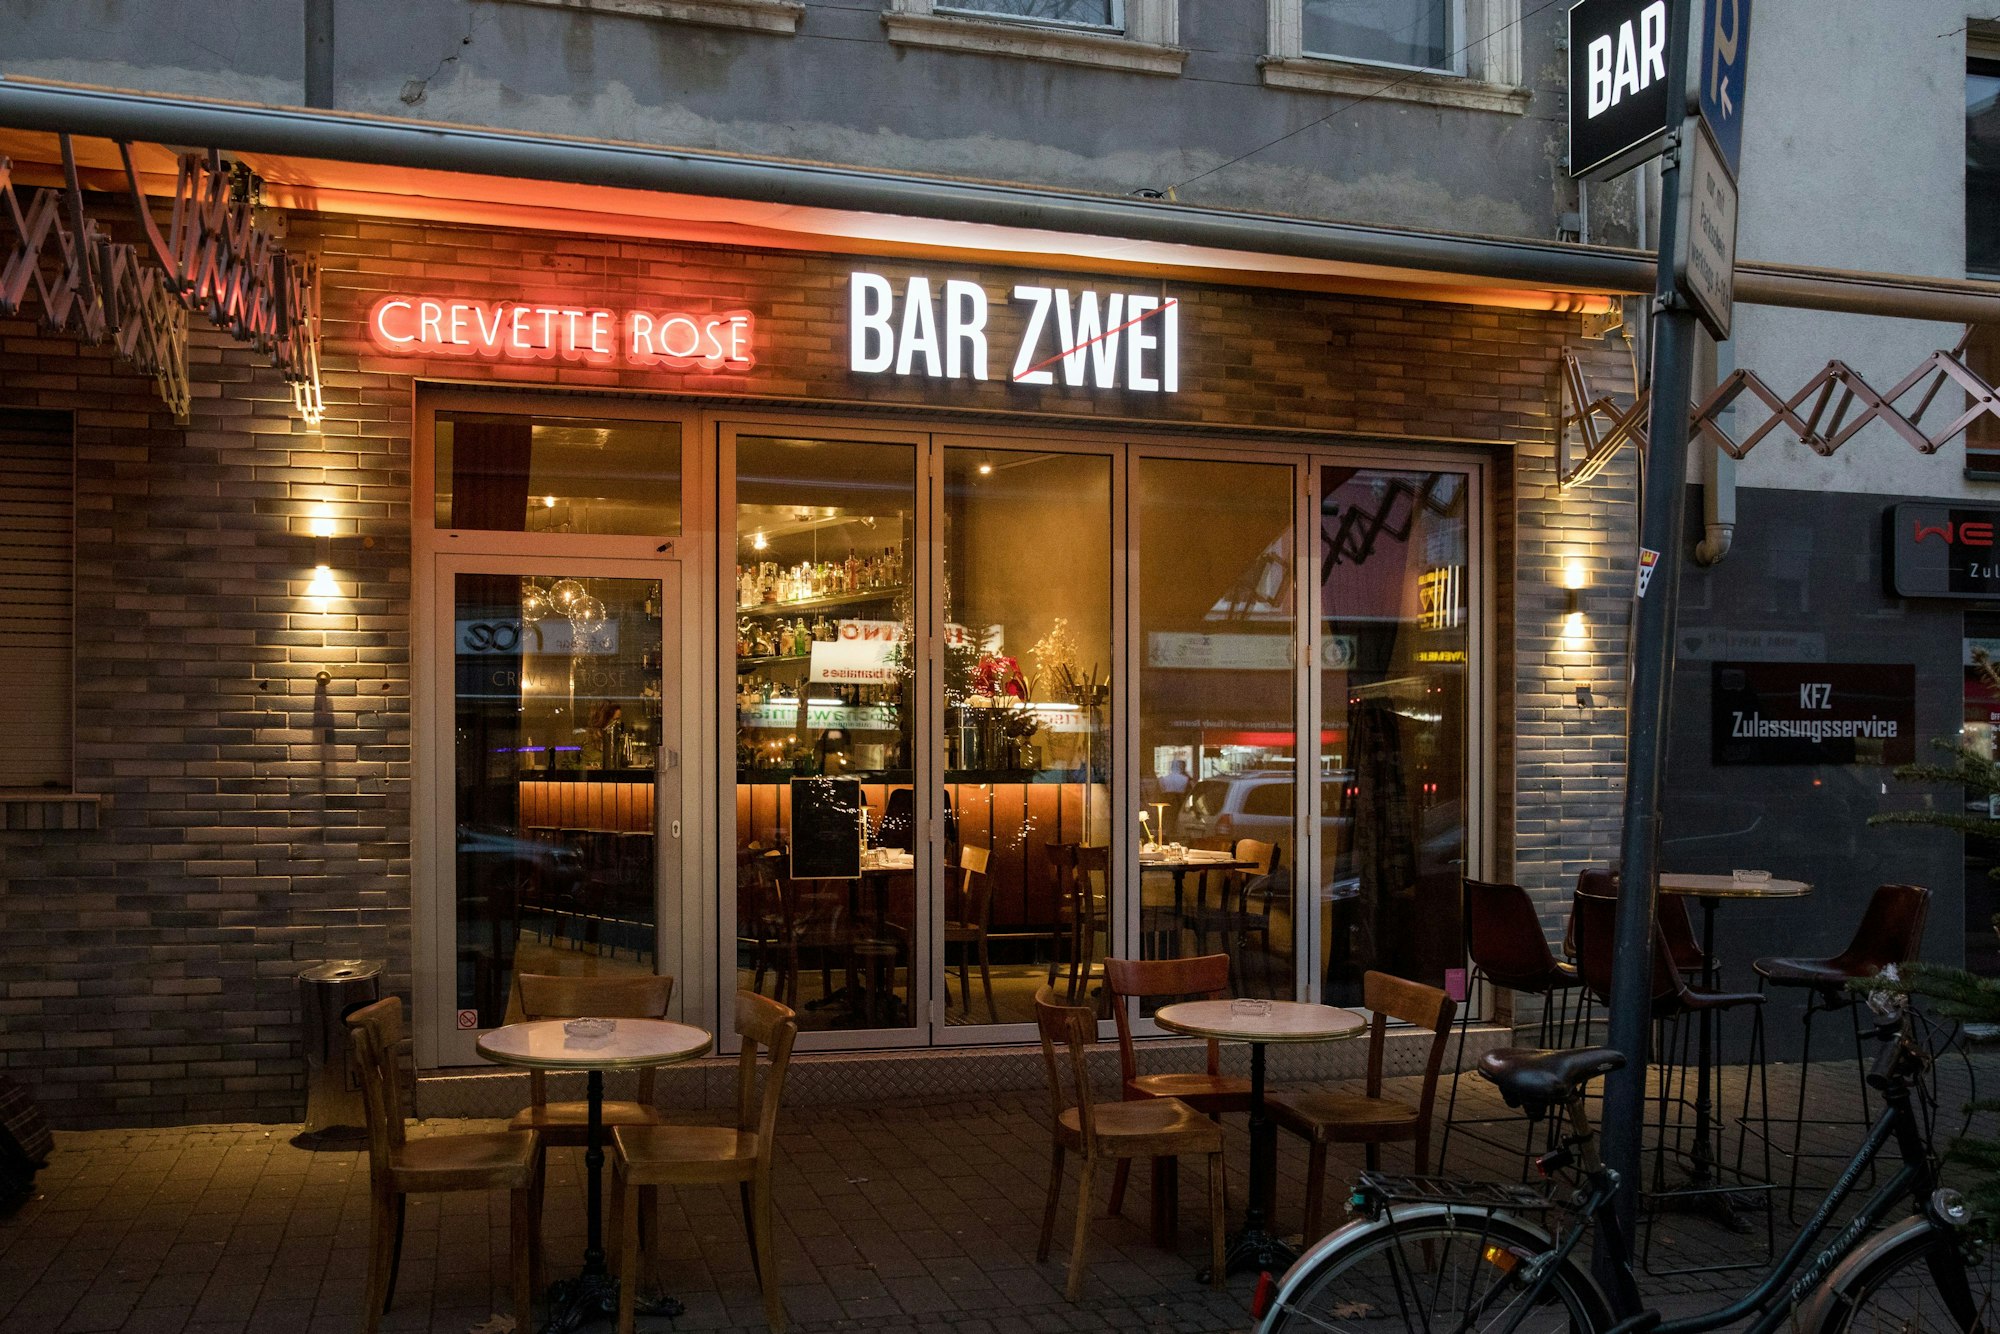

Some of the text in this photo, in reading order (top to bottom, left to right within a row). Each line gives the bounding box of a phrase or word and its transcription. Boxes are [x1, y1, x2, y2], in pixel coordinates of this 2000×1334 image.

[1588, 0, 1666, 119] BAR
[376, 300, 611, 354] CREVETTE
[850, 271, 1179, 393] BAR ZWEI
[1799, 683, 1832, 710] KFZ
[1732, 711, 1897, 743] Zulassungsservice
